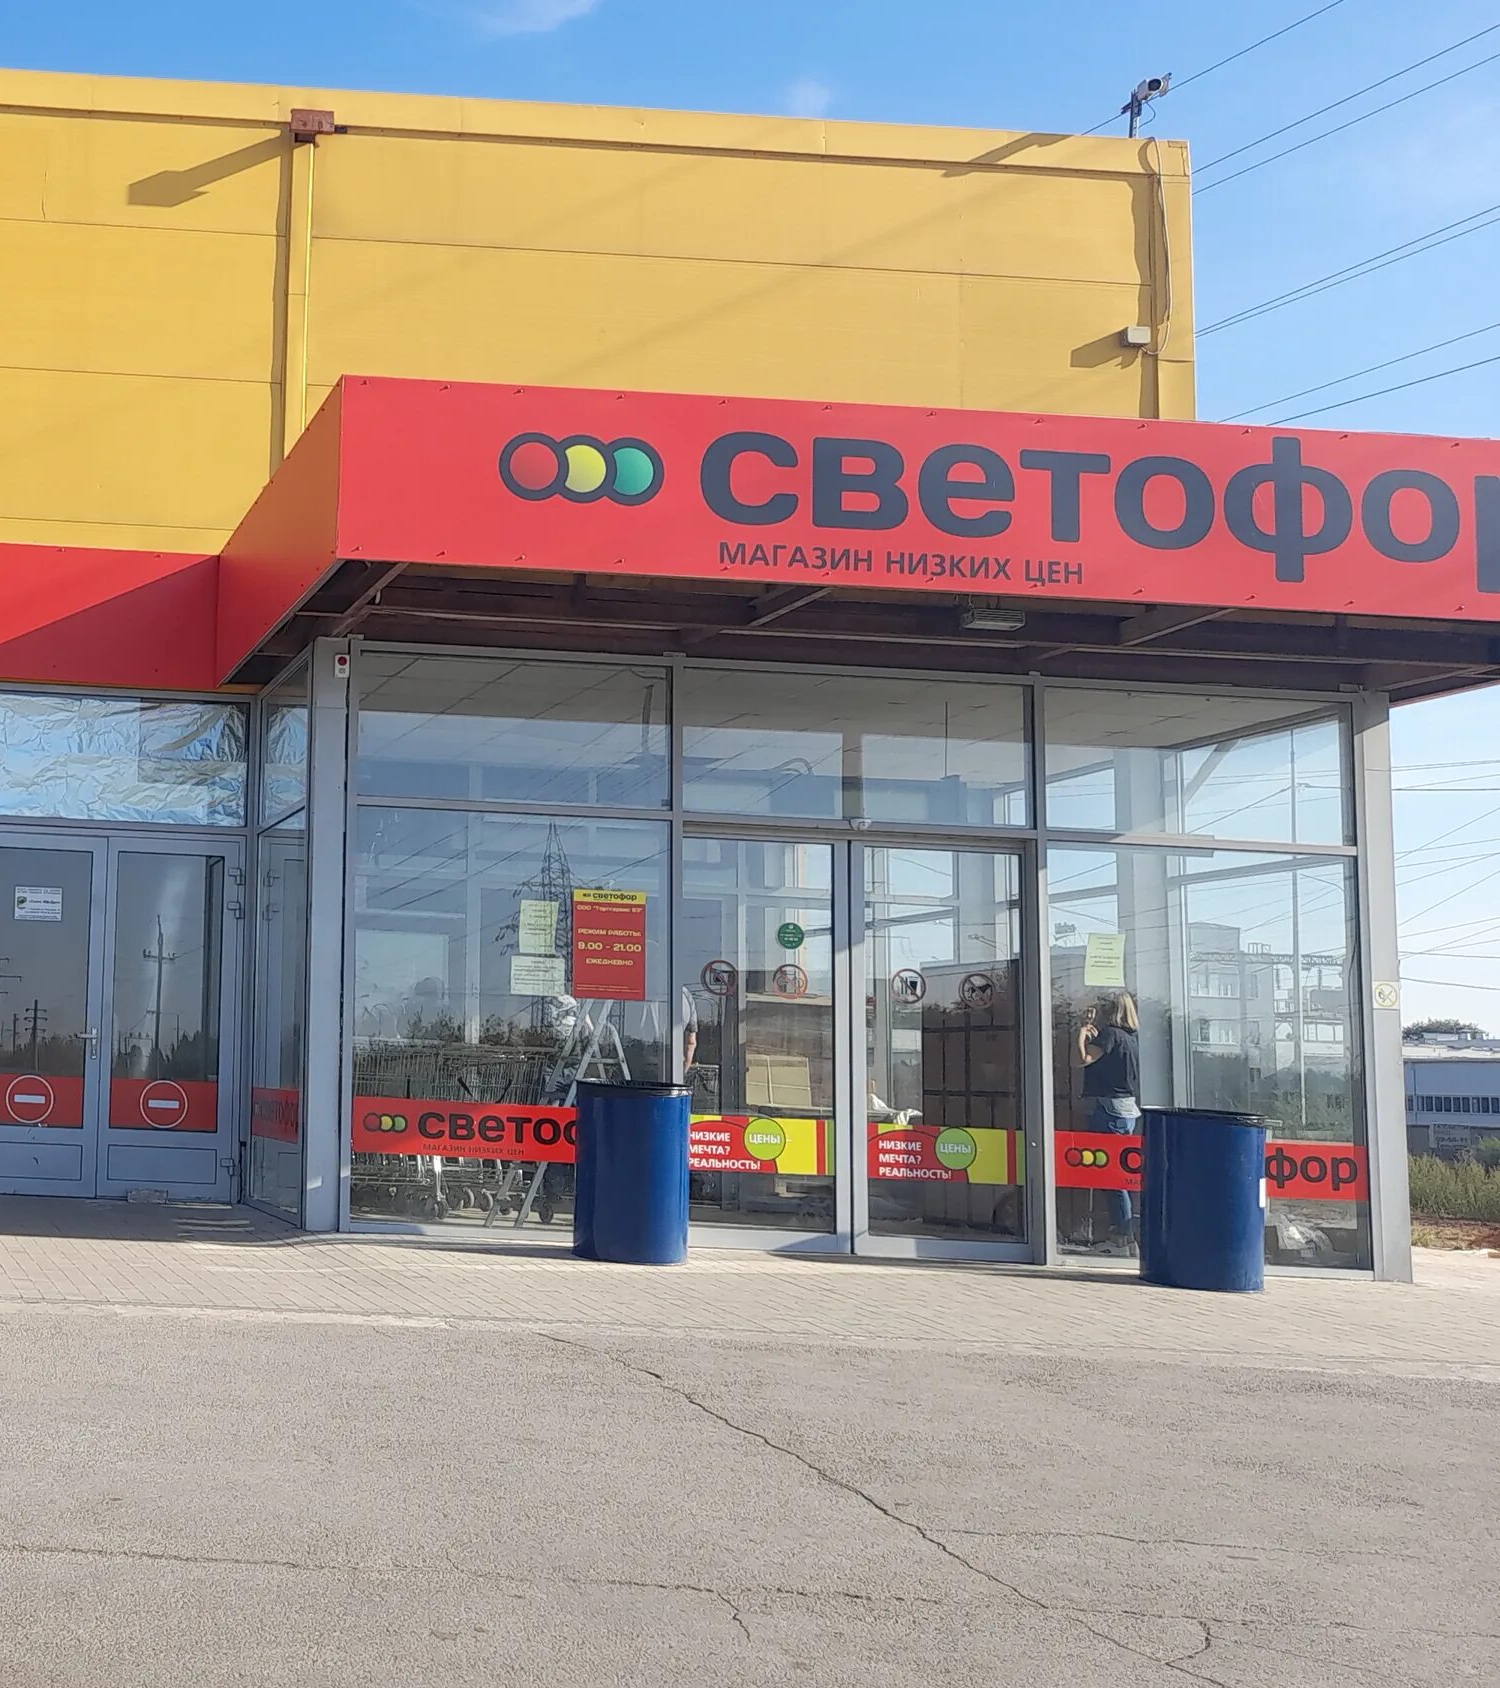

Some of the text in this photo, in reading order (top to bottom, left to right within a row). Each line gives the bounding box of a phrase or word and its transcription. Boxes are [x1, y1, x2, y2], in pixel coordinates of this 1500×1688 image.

[719, 541, 1084, 585] МАГАЗИН НИЗКИХ ЦЕН
[578, 941, 603, 951] 9.00
[613, 943, 642, 952] 21.00
[418, 1112, 576, 1146] свето
[749, 1133, 780, 1144] ЦЕНЫ
[422, 1143, 465, 1153] МАГАЗИН
[879, 1140, 922, 1151] НИЗКИЕ
[940, 1143, 971, 1154] ЦЕНЫ
[689, 1157, 761, 1170] РЕАЛЬНОСТЬ!
[879, 1153, 921, 1164] МЕЧТА?
[879, 1166, 952, 1179] РЕАЛЬНОСТЬ!
